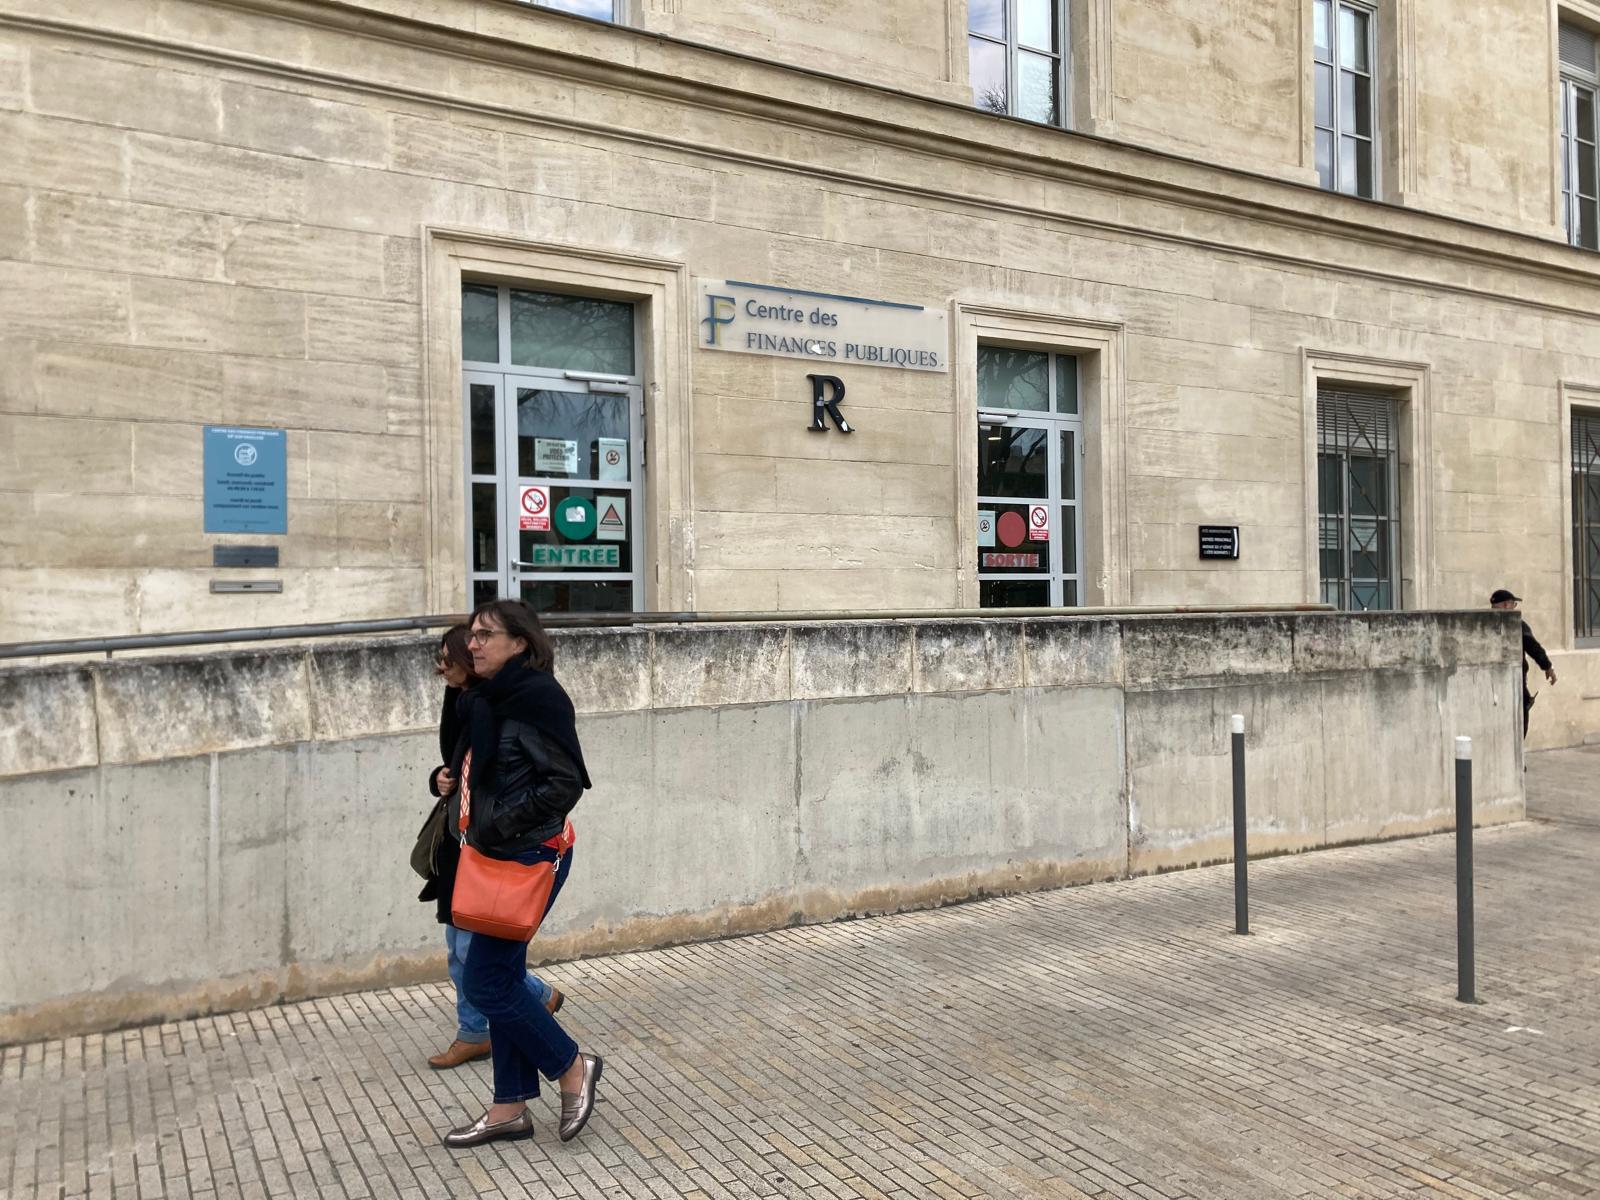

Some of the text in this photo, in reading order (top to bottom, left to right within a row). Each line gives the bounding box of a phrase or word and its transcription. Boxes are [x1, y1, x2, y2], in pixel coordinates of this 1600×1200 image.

[745, 299, 838, 327] Centre des
[747, 332, 938, 367] FINANCES PUBLIQUES
[806, 374, 855, 434] R
[985, 554, 1037, 567] SORTIE
